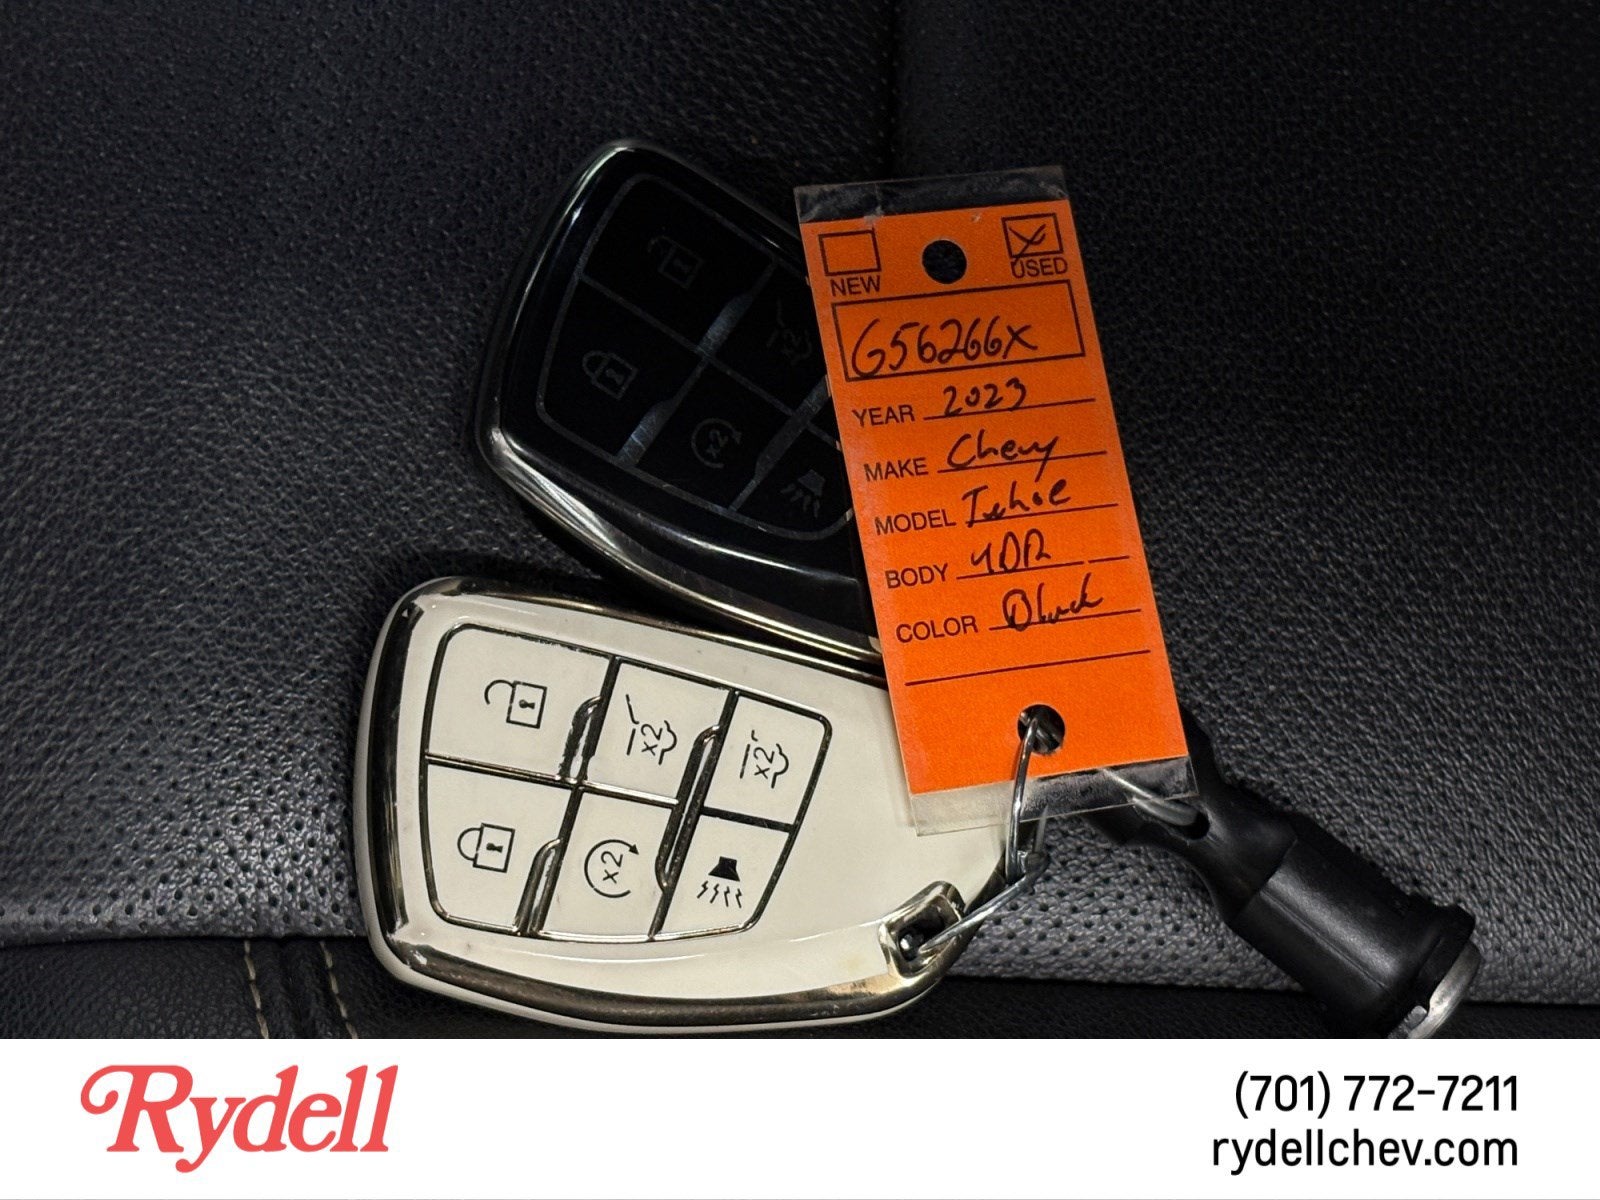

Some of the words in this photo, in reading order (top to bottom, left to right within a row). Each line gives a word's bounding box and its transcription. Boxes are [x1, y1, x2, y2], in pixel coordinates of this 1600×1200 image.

[1011, 257, 1069, 279] USED
[830, 275, 881, 297] NEW
[852, 404, 915, 427] YEAR
[942, 377, 1027, 417] 2023
[863, 457, 929, 482] MAKE
[874, 509, 956, 536] MODEL
[885, 563, 948, 589] BODY
[895, 615, 979, 643] COLOR
[600, 850, 624, 884] x2
